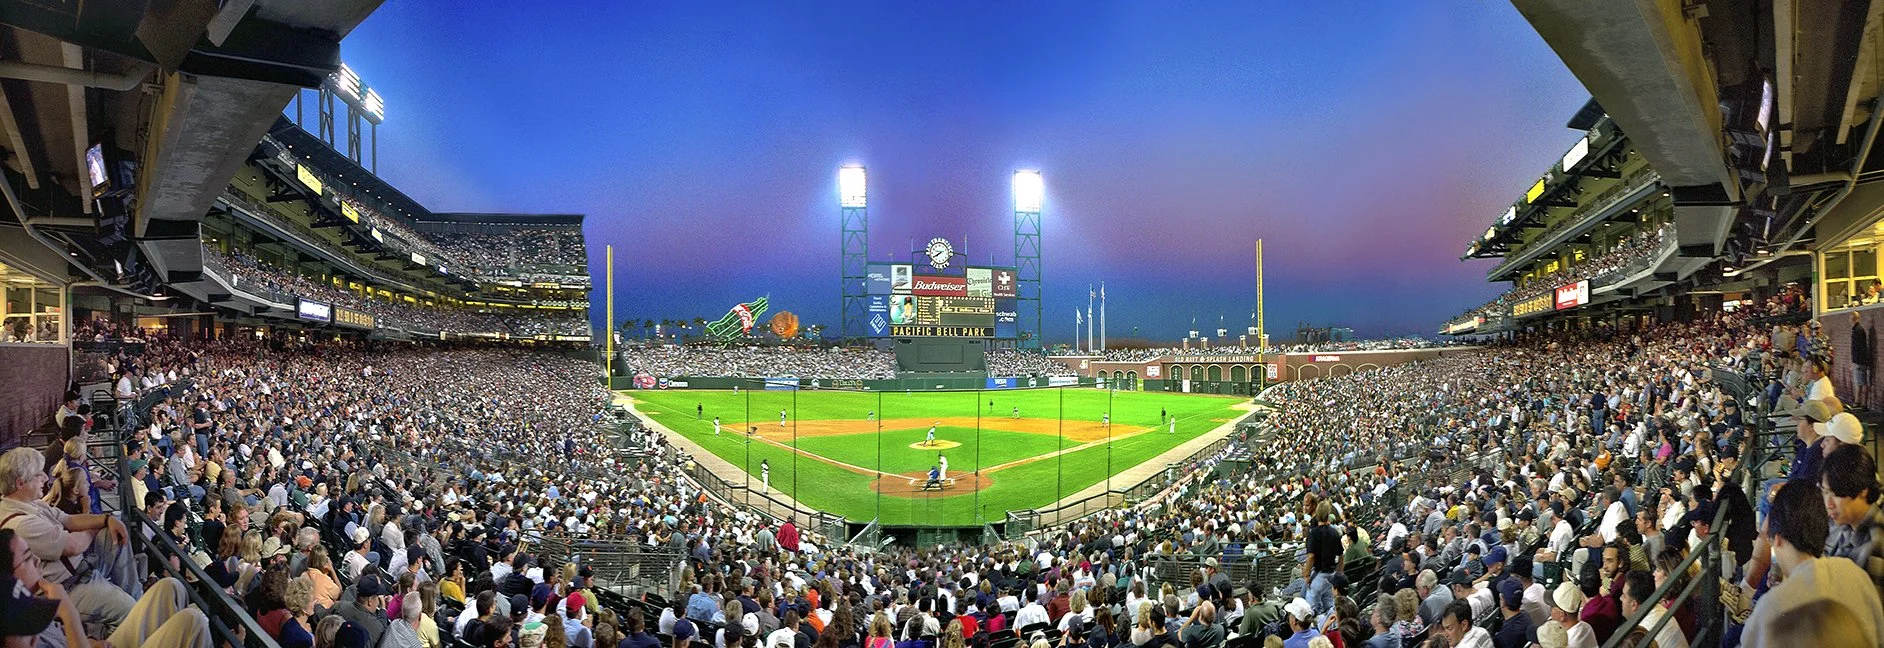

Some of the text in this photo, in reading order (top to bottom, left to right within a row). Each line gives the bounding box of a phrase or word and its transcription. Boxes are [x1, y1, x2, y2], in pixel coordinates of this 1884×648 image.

[913, 280, 965, 291] Budweiser
[893, 327, 985, 336] PACIFIC BELL PARK
